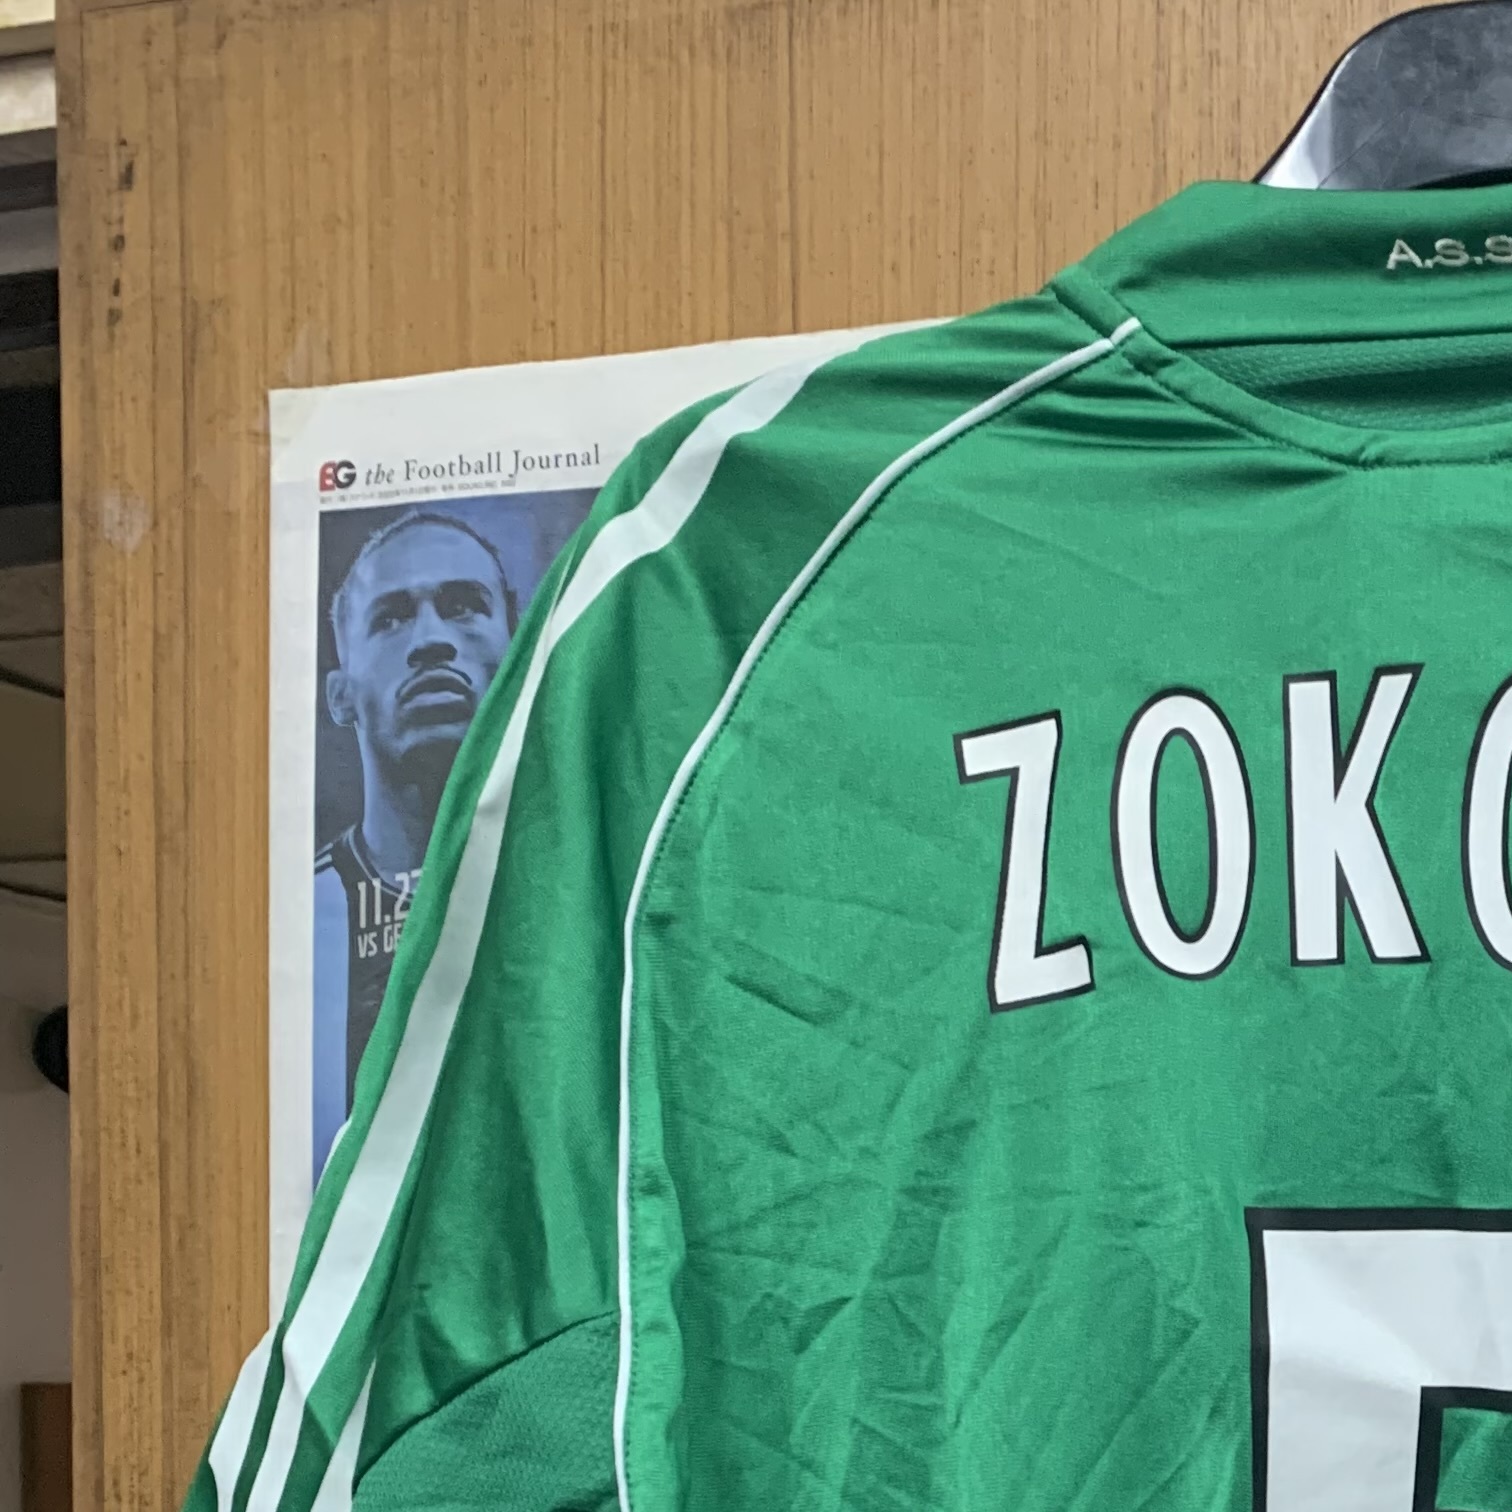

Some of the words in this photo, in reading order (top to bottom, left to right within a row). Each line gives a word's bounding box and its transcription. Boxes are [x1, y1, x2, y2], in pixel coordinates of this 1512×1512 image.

[365, 463, 395, 486] the
[404, 452, 502, 481] Football
[508, 443, 600, 478] Journal
[357, 931, 378, 958] VS
